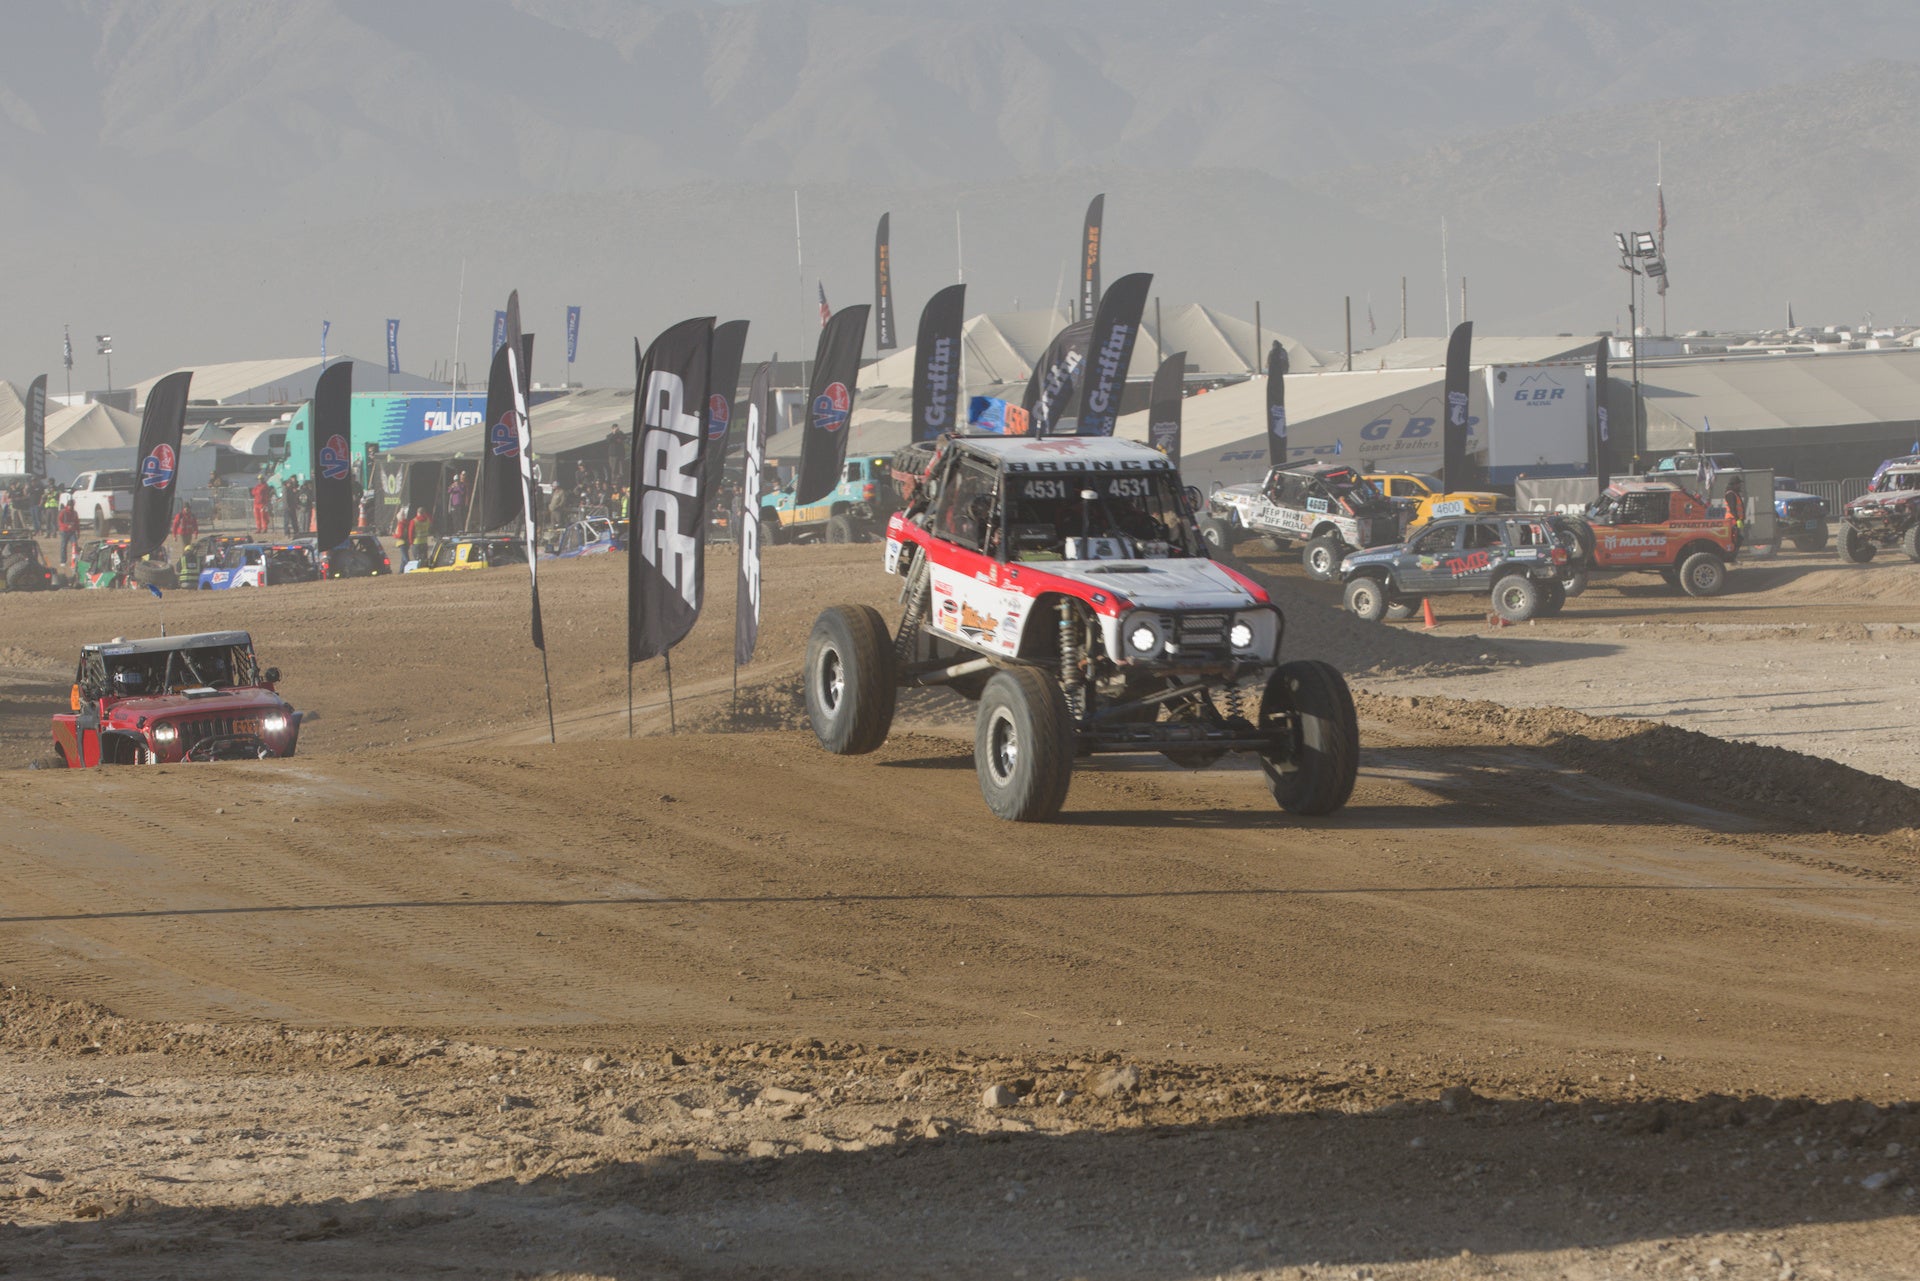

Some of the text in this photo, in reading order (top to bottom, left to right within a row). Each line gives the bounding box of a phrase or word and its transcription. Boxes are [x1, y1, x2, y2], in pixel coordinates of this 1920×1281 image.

[1092, 324, 1128, 413] Griffin
[924, 336, 951, 426] Griffin
[1514, 388, 1565, 400] GBR
[424, 411, 482, 431] FALKEN
[813, 395, 849, 428] VP
[32, 386, 45, 476] can-am
[491, 423, 519, 455] VP
[1394, 439, 1440, 450] Brothers
[142, 456, 174, 487] VP
[320, 447, 349, 478] VP
[1007, 460, 1170, 472] BRONCO
[642, 370, 701, 611] PRP
[1024, 480, 1066, 498] 4531
[1109, 478, 1150, 497] 4531
[1437, 502, 1460, 513] 4600
[1619, 536, 1667, 547] MAXXIS
[1445, 551, 1490, 575] TMR
